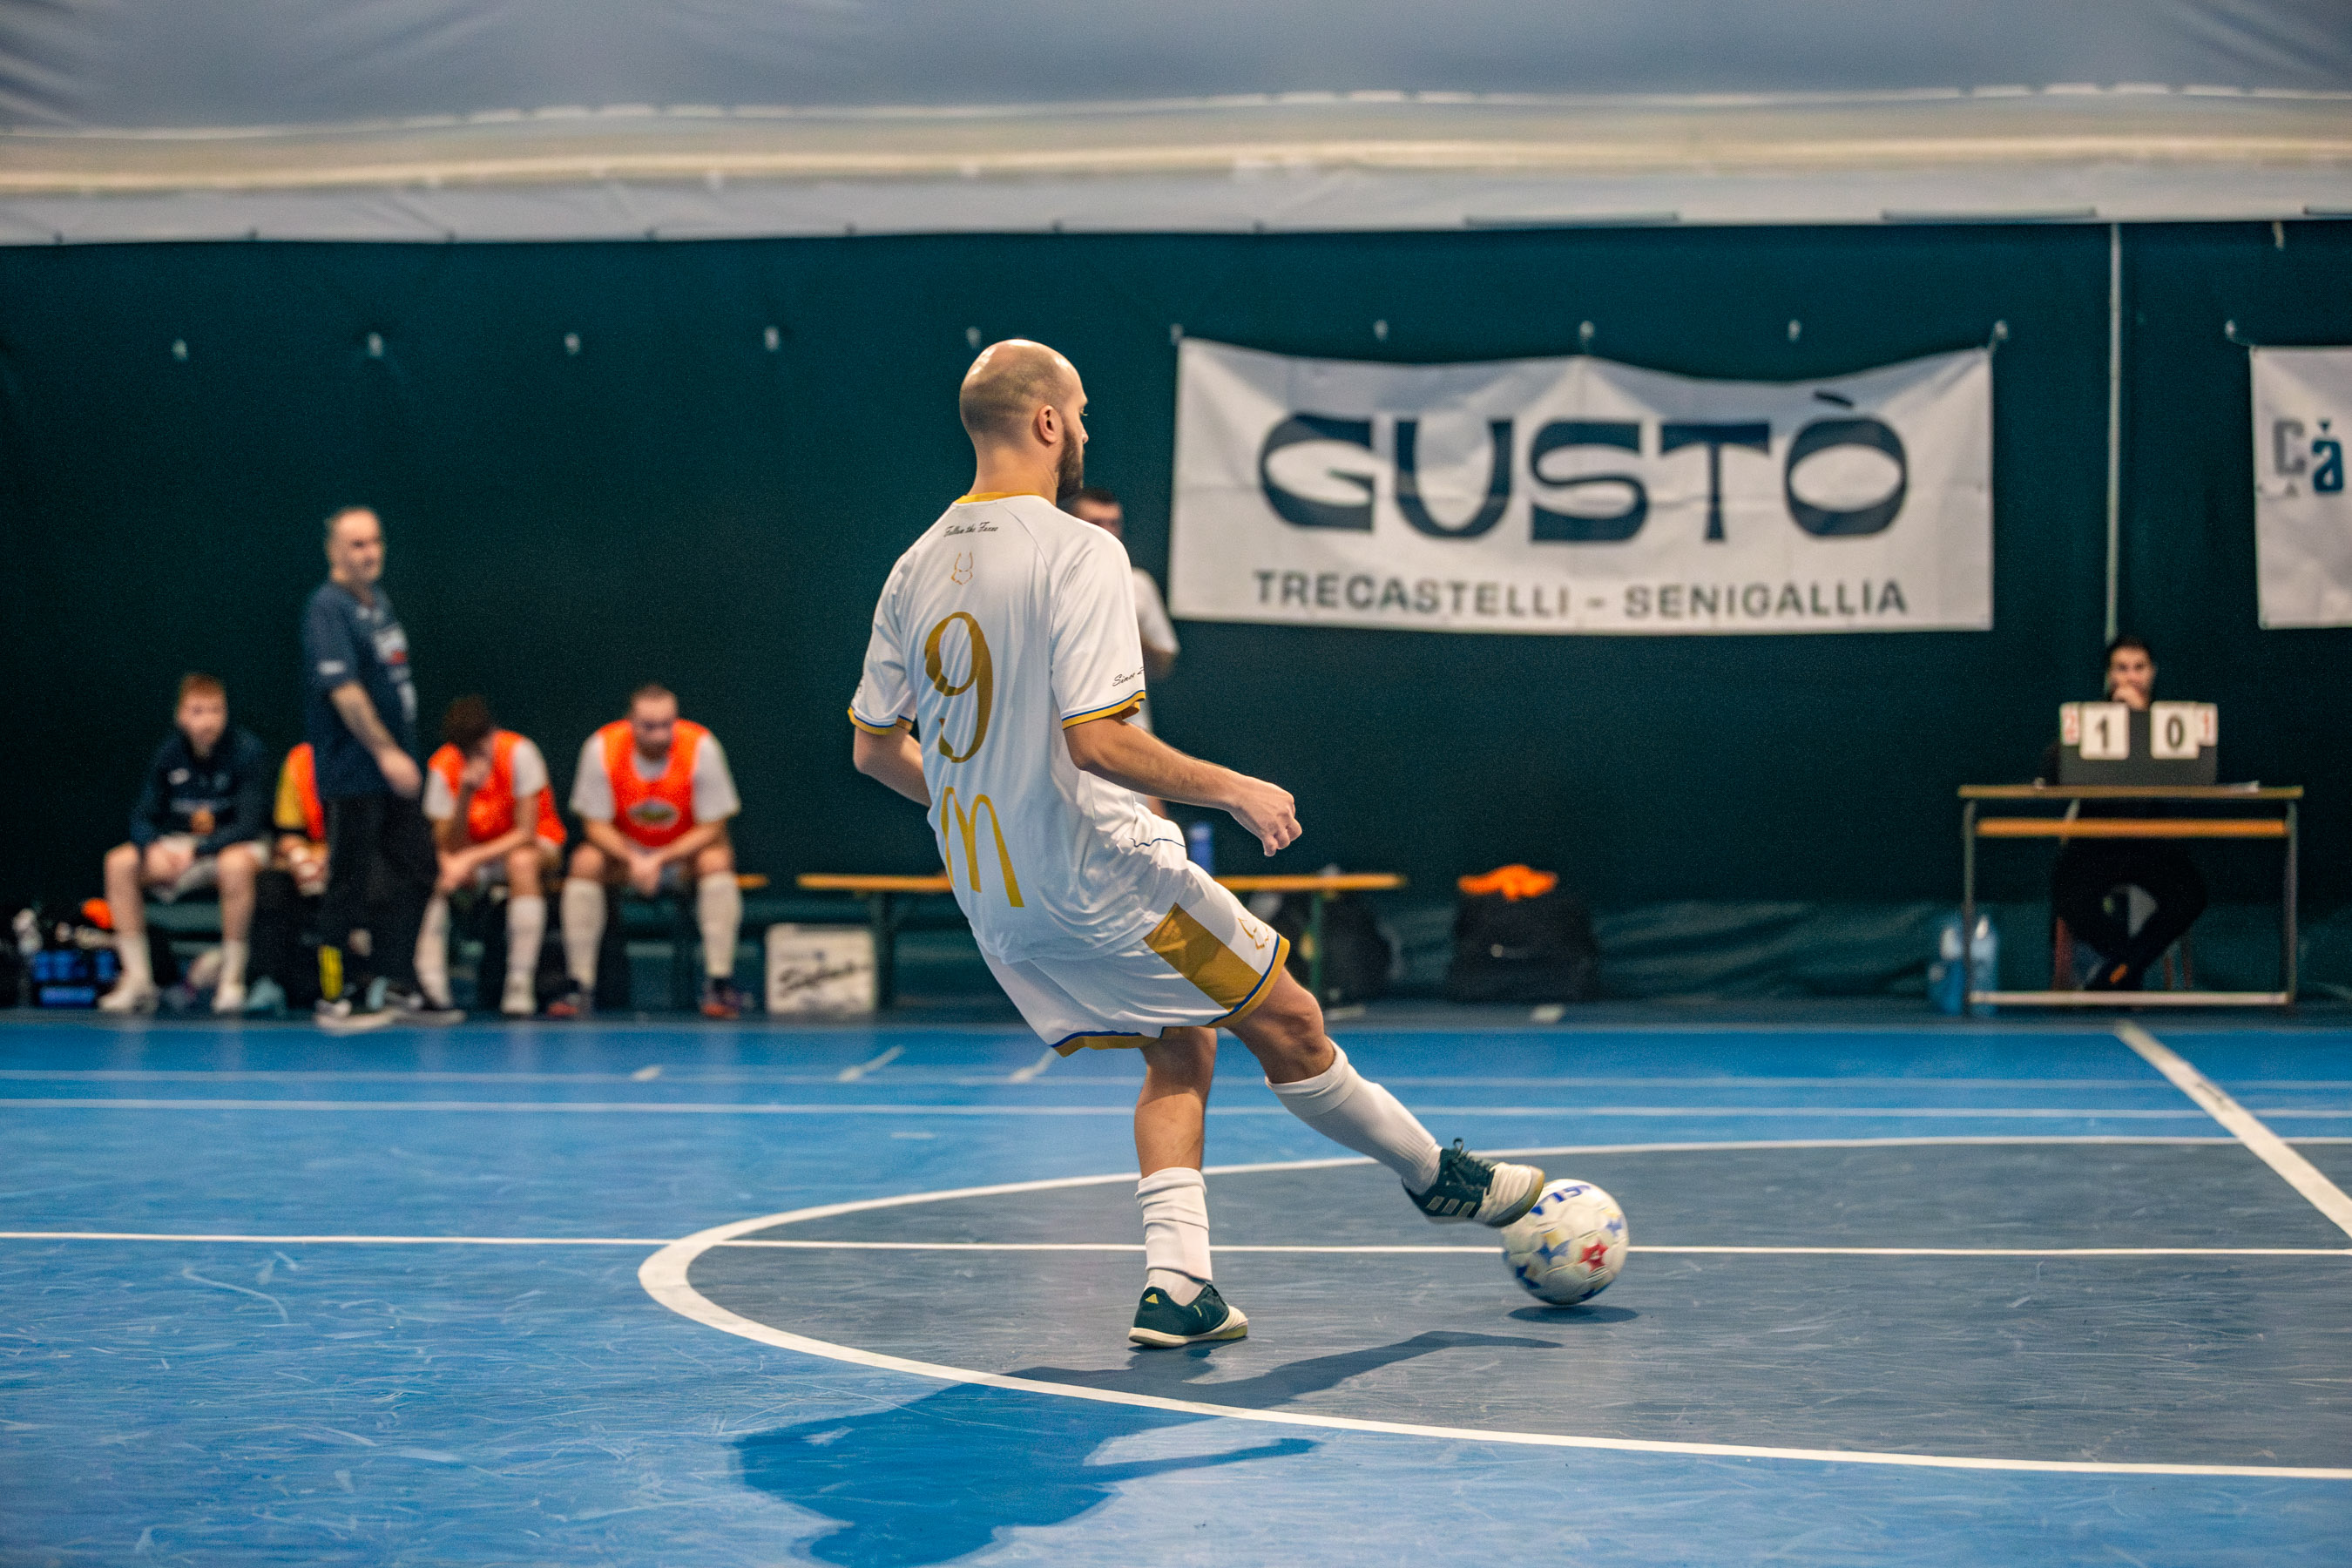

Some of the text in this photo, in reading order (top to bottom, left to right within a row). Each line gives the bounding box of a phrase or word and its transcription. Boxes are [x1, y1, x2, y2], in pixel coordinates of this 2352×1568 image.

[1258, 389, 1908, 544] GUSTÒ
[1254, 569, 1570, 618] TRECASTELLI
[1624, 578, 1909, 618] SENIGALLIA
[924, 611, 994, 764] 9
[1112, 672, 1136, 687] Since
[2095, 713, 2109, 750] 1
[2165, 713, 2185, 749] 0
